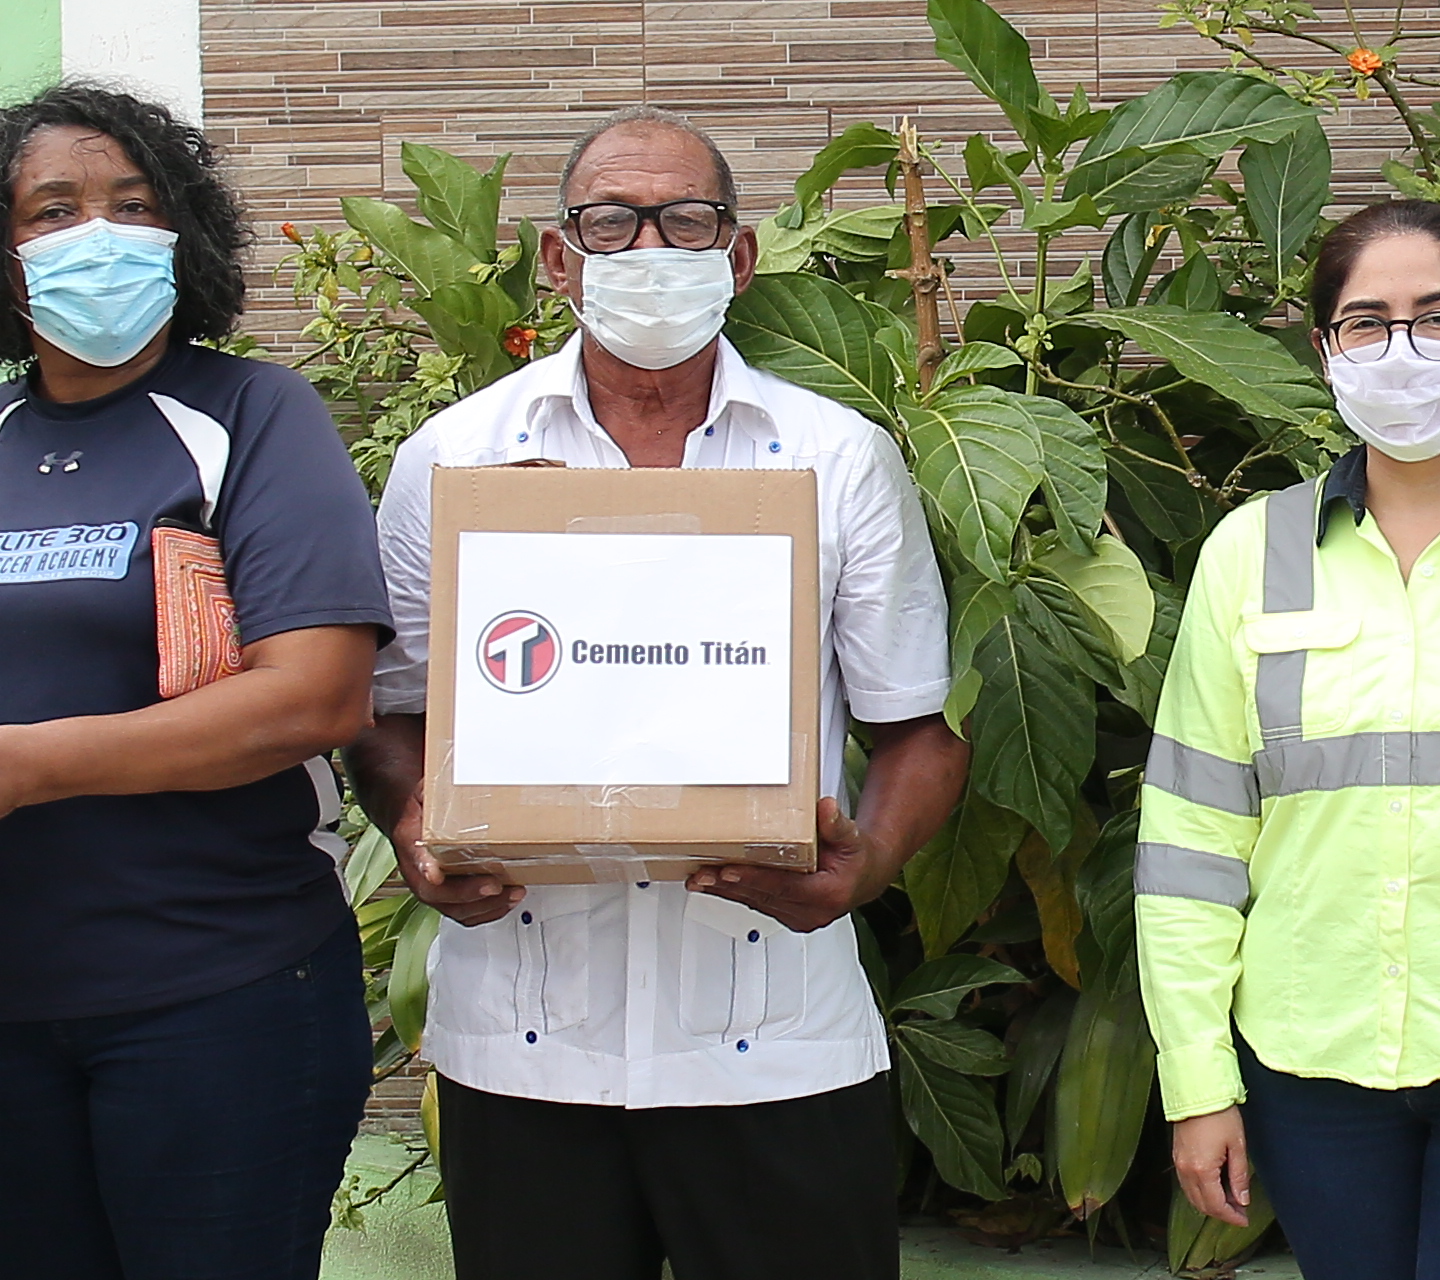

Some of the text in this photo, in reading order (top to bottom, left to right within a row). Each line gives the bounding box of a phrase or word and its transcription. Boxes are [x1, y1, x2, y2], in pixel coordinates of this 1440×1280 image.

[65, 526, 128, 545] 300
[37, 548, 120, 572] ACADEMY
[571, 639, 767, 666] Cemento Titán
